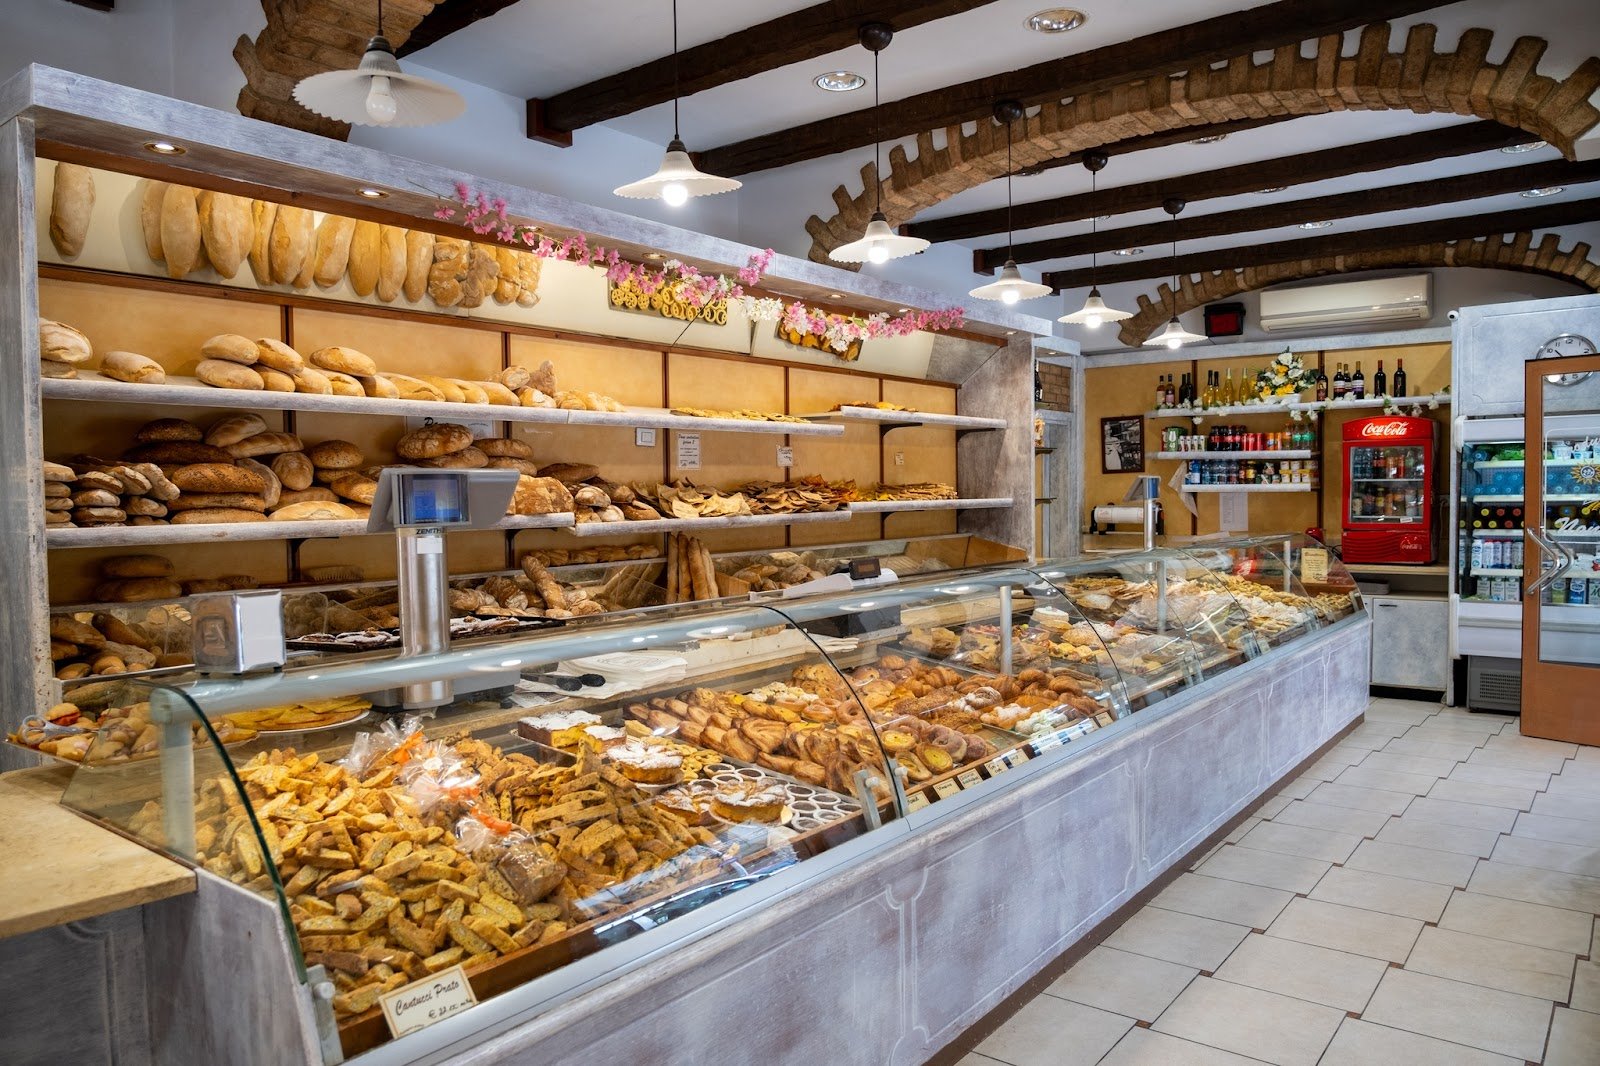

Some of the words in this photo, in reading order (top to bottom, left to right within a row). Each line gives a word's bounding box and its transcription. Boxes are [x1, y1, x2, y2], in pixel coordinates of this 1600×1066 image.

[1362, 421, 1409, 436] Coca-Cola
[395, 990, 433, 1016] Cantucci
[433, 981, 460, 998] Prato
